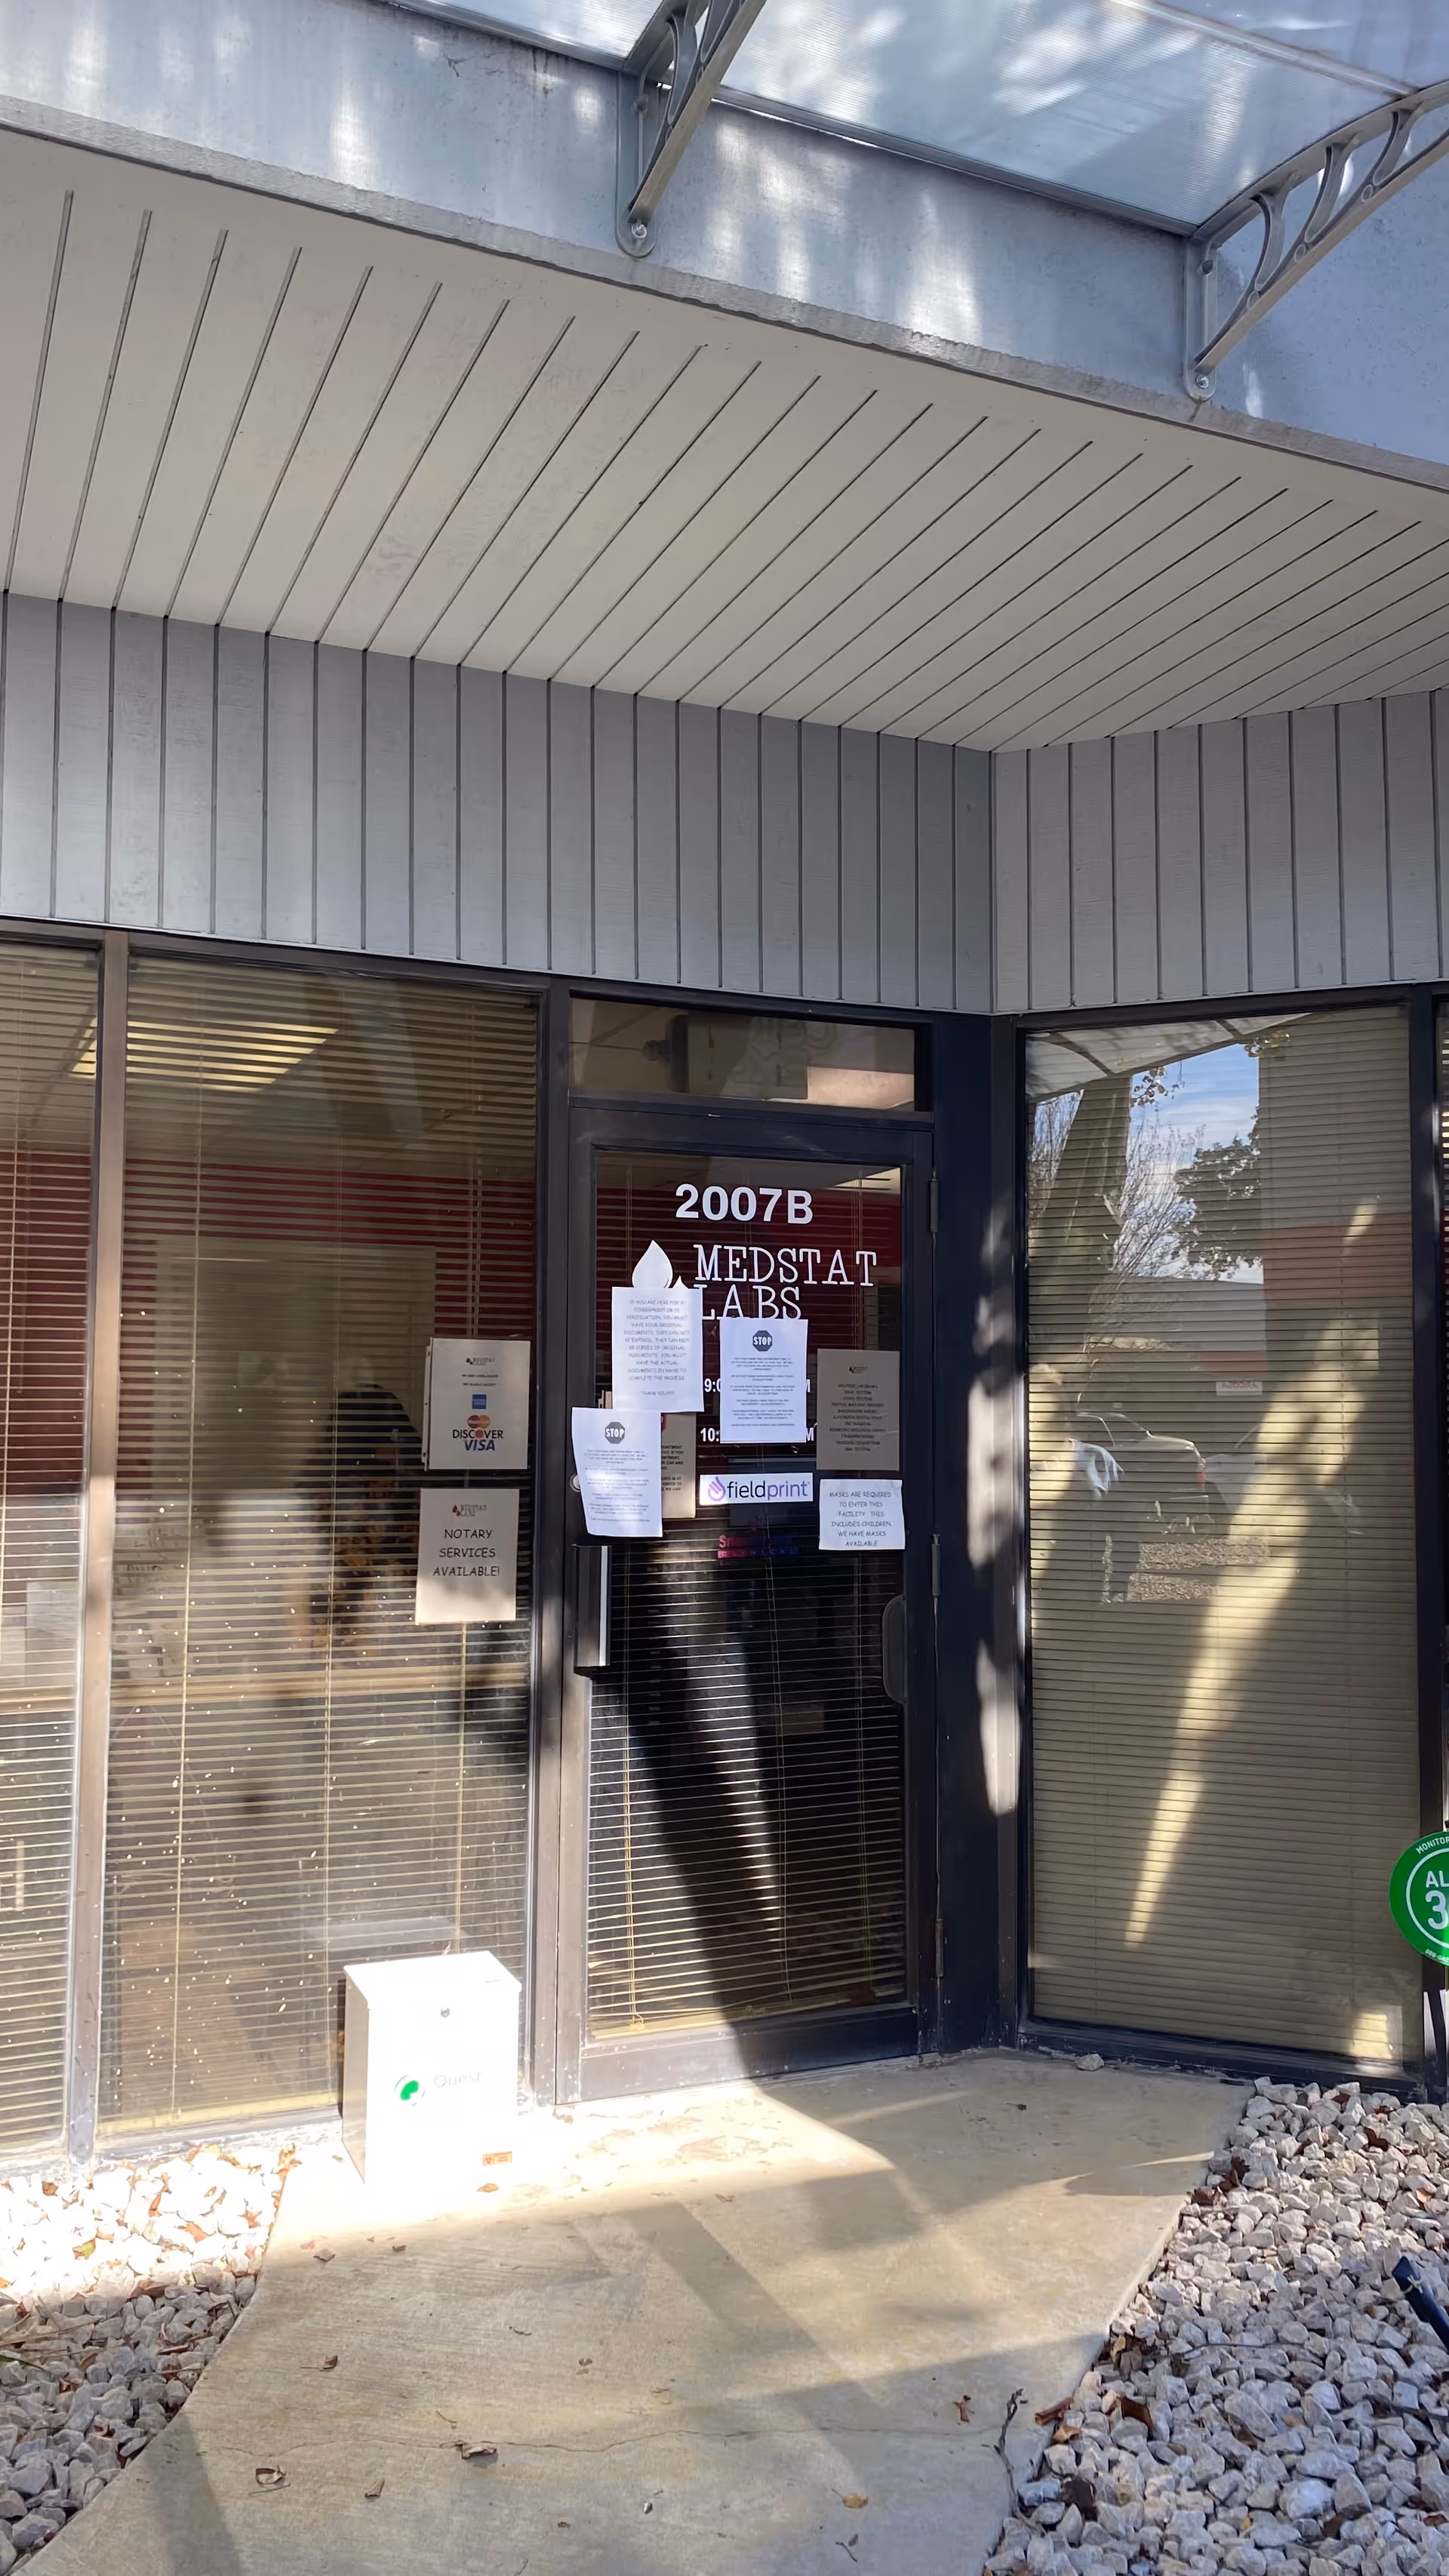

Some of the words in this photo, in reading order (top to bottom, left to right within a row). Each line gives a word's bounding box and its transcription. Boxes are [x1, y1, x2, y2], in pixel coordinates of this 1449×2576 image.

[675, 1183, 814, 1224] 2007B
[693, 1245, 877, 1286] MEDSTAT
[694, 1284, 801, 1320] LABS
[754, 1337, 772, 1346] STOP
[453, 1430, 503, 1439] DISCOVER
[605, 1428, 625, 1438] STOP
[465, 1439, 495, 1451] VISA
[727, 1480, 808, 1500] fieldprint
[445, 1529, 493, 1539] NOTARY
[438, 1547, 496, 1558] SERVICES
[432, 1566, 500, 1576] AVAILABLE!
